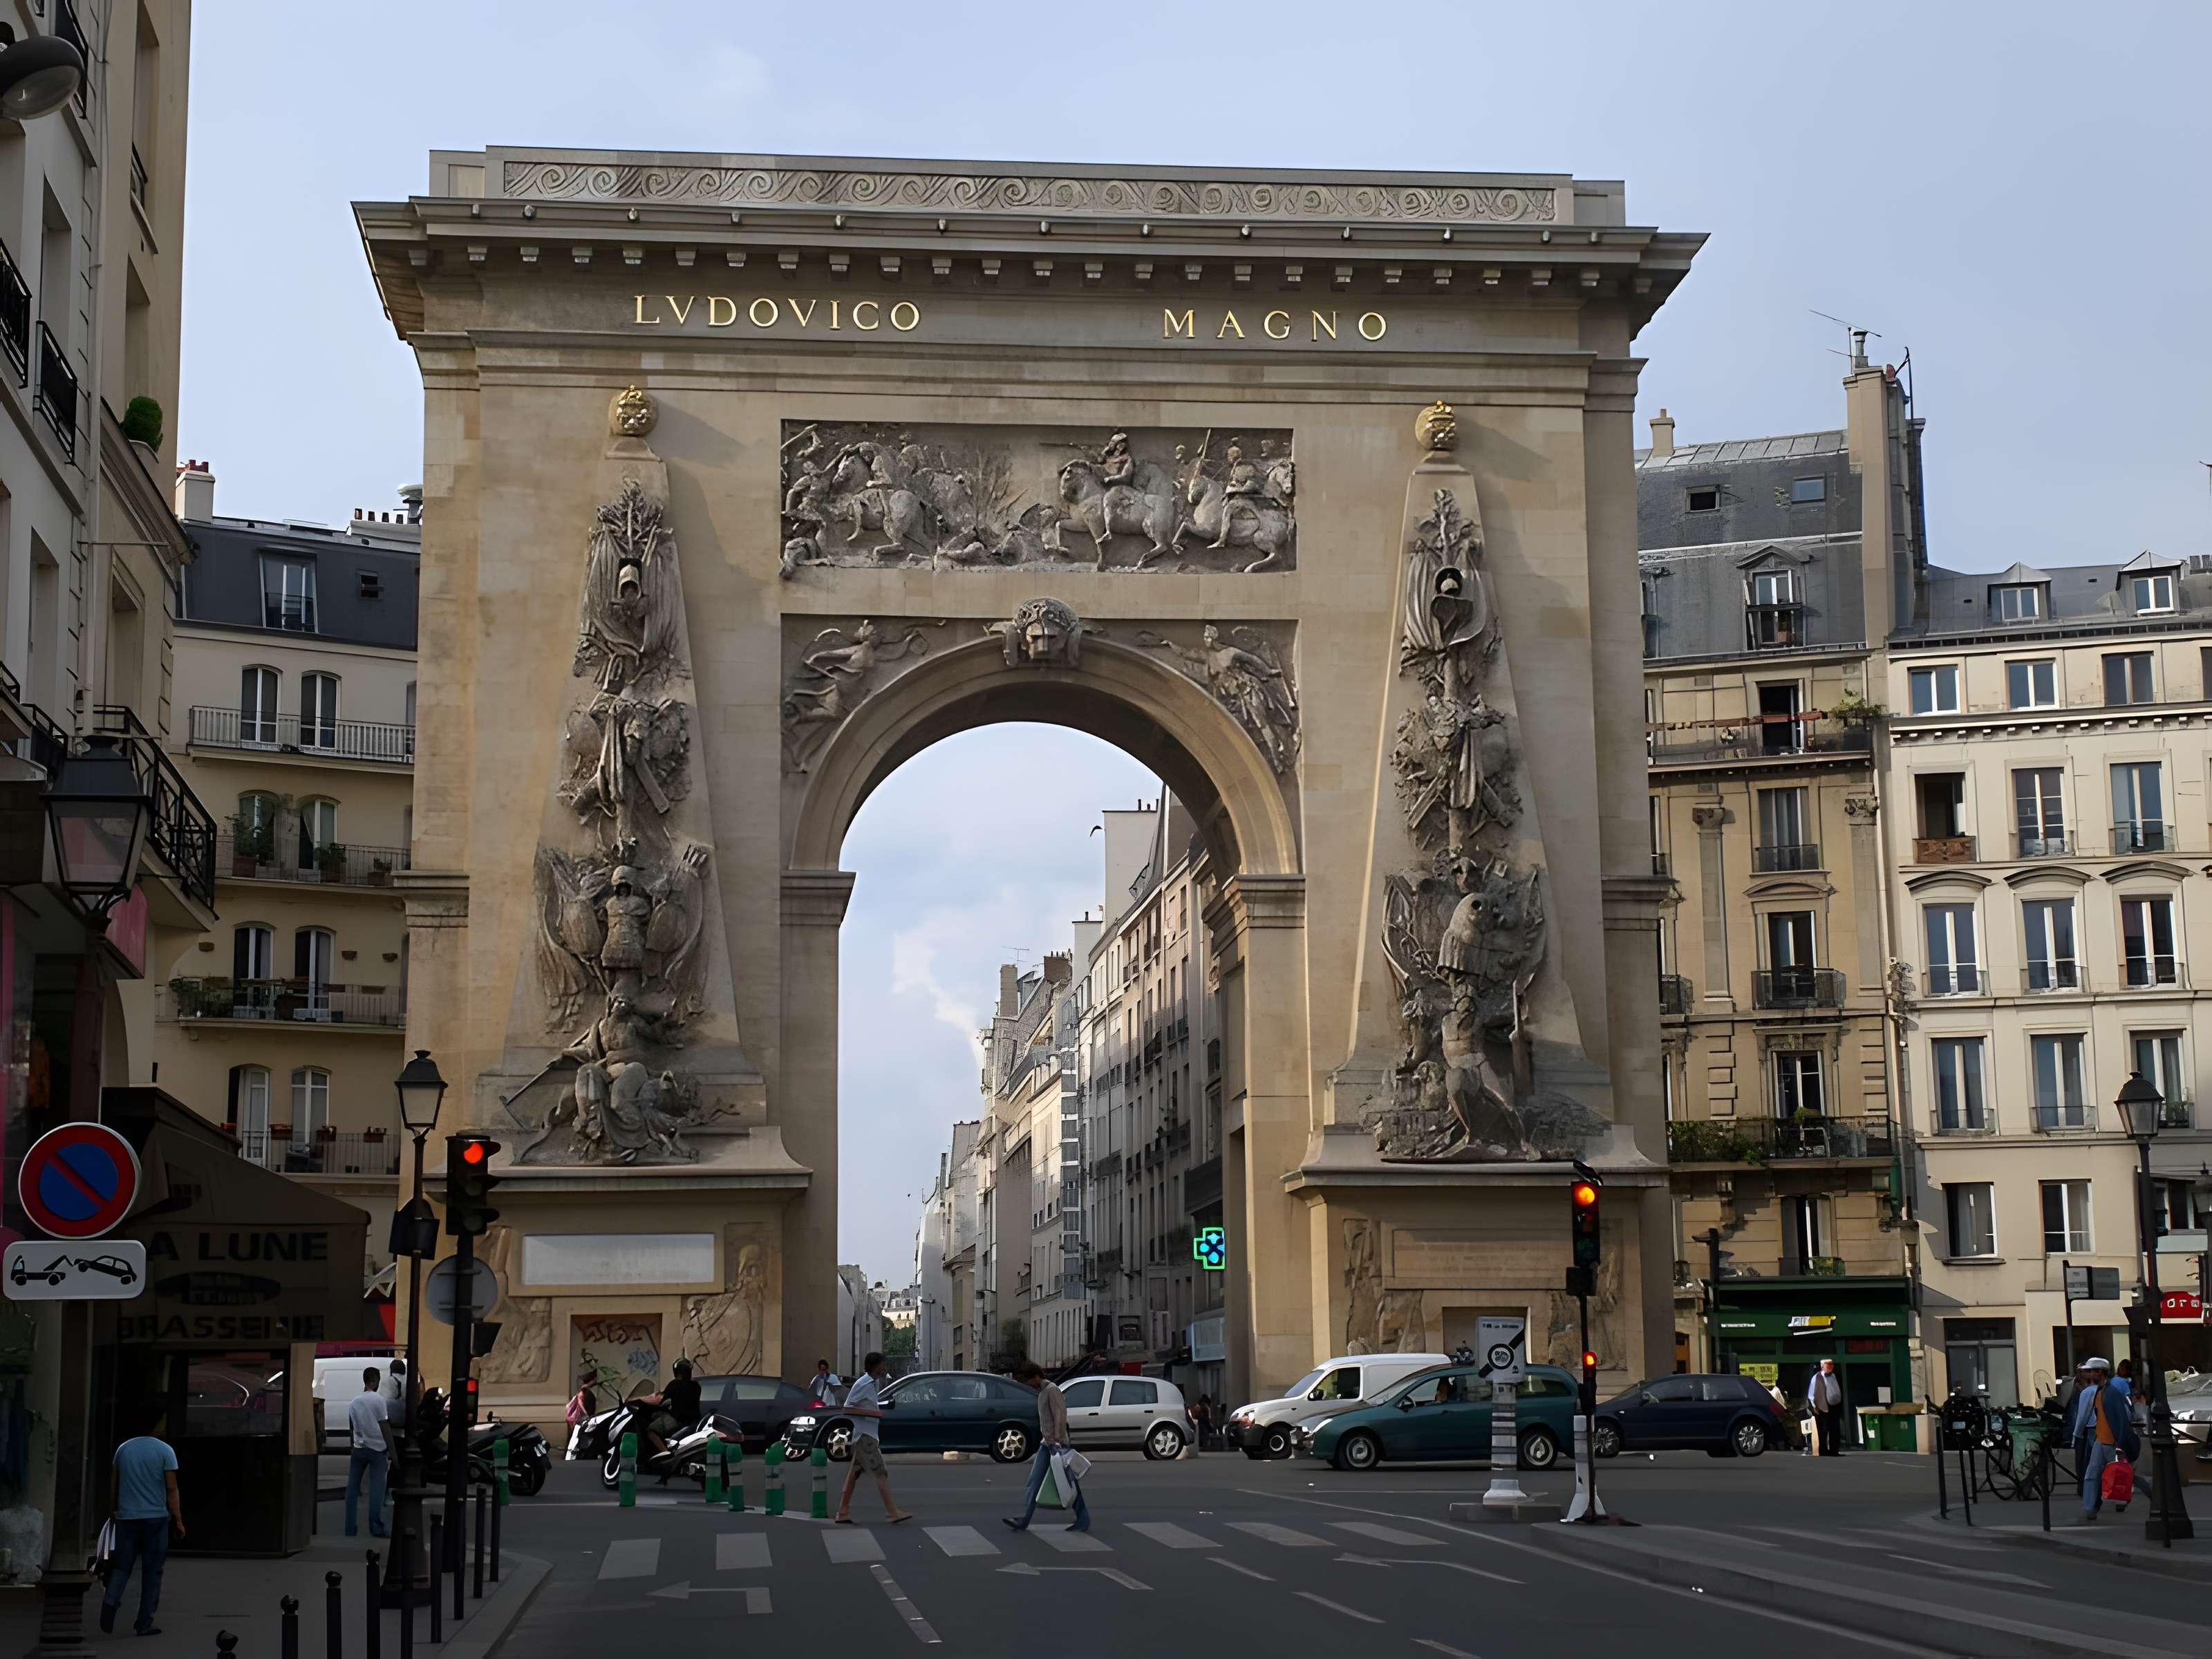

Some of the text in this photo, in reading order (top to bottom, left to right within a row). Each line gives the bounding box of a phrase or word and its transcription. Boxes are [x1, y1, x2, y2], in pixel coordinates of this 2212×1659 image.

[633, 294, 1387, 342] LVDOVICO MAGNO
[198, 1232, 328, 1262] LUNE
